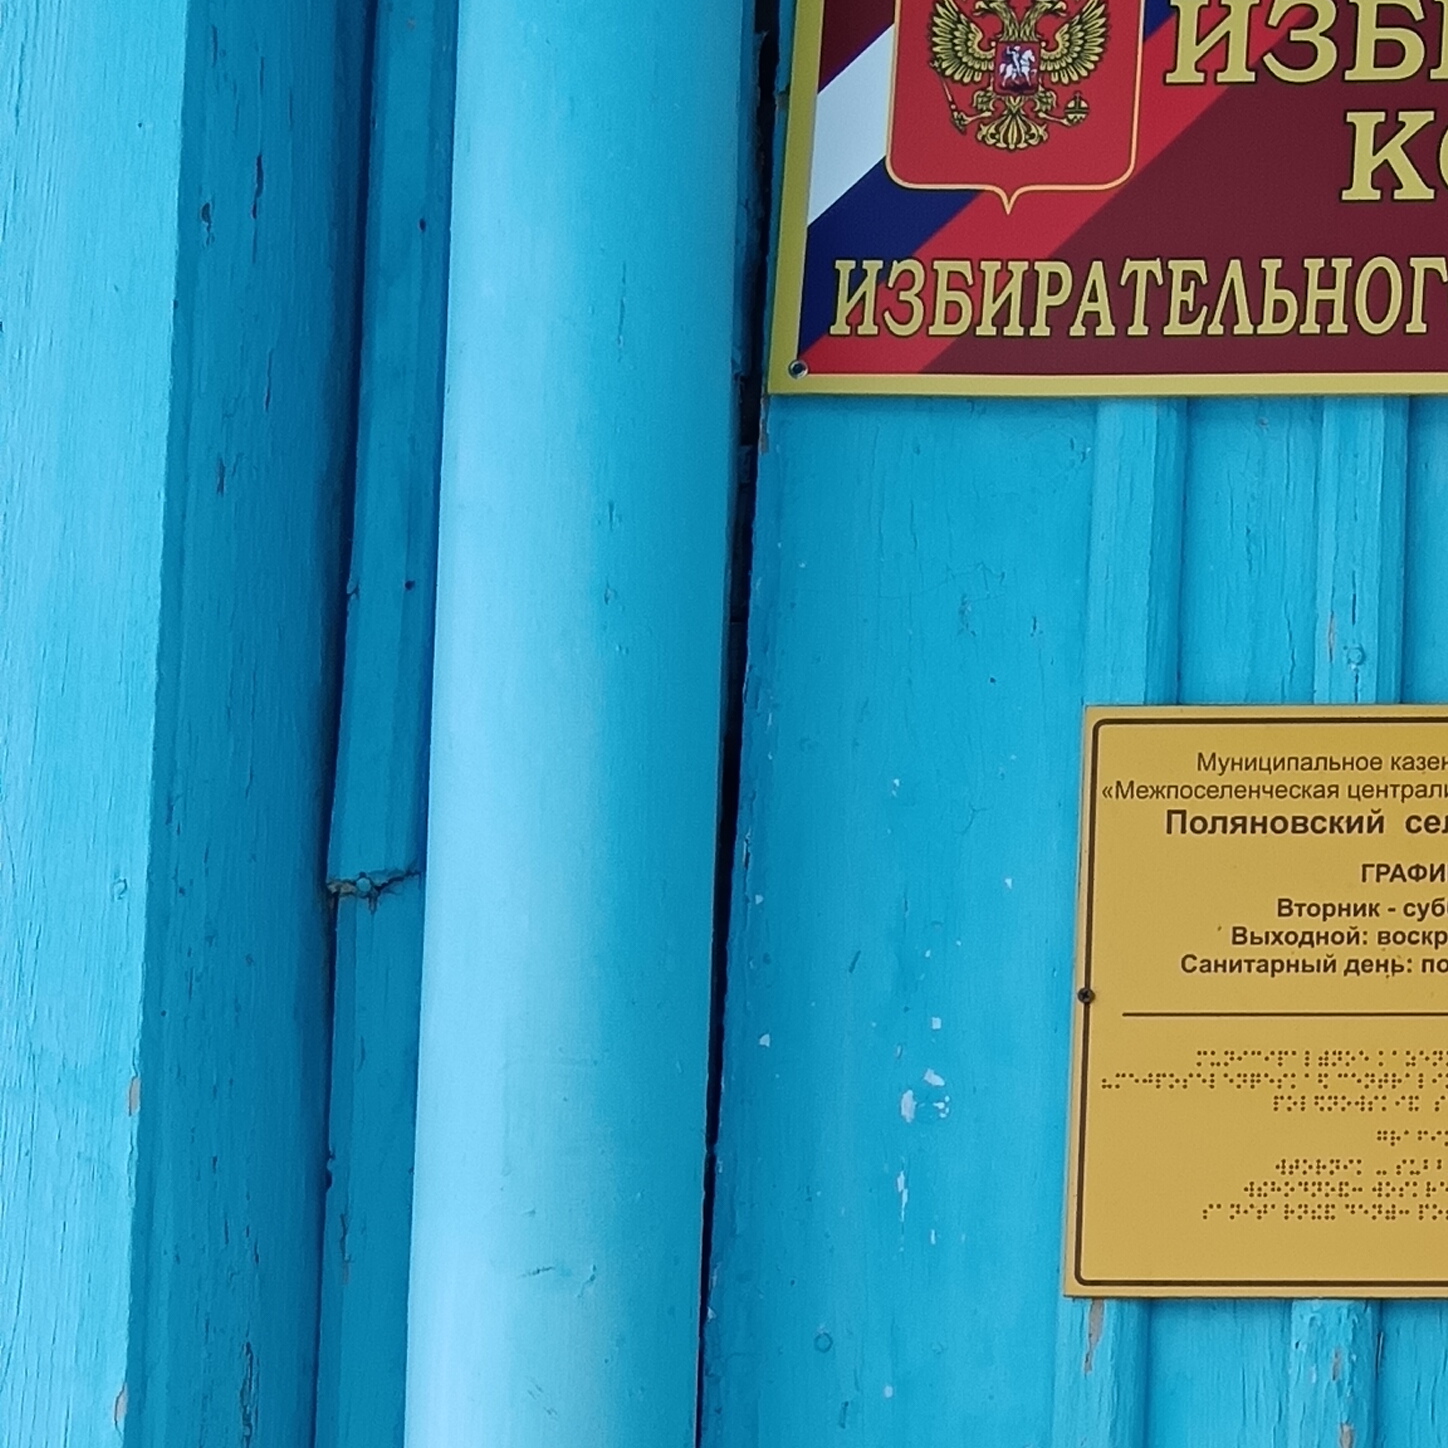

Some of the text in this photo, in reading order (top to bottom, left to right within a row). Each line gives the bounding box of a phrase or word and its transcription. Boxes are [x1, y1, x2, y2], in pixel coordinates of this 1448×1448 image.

[1197, 752, 1383, 776] Муниципальное
[1101, 780, 1339, 800] «Межпоселенческая
[1166, 808, 1384, 835] Поляновский
[1277, 898, 1380, 921] Вторник
[1231, 926, 1368, 949] Выходной:
[1181, 953, 1336, 978] Санитарный
[1343, 958, 1412, 978] день:
